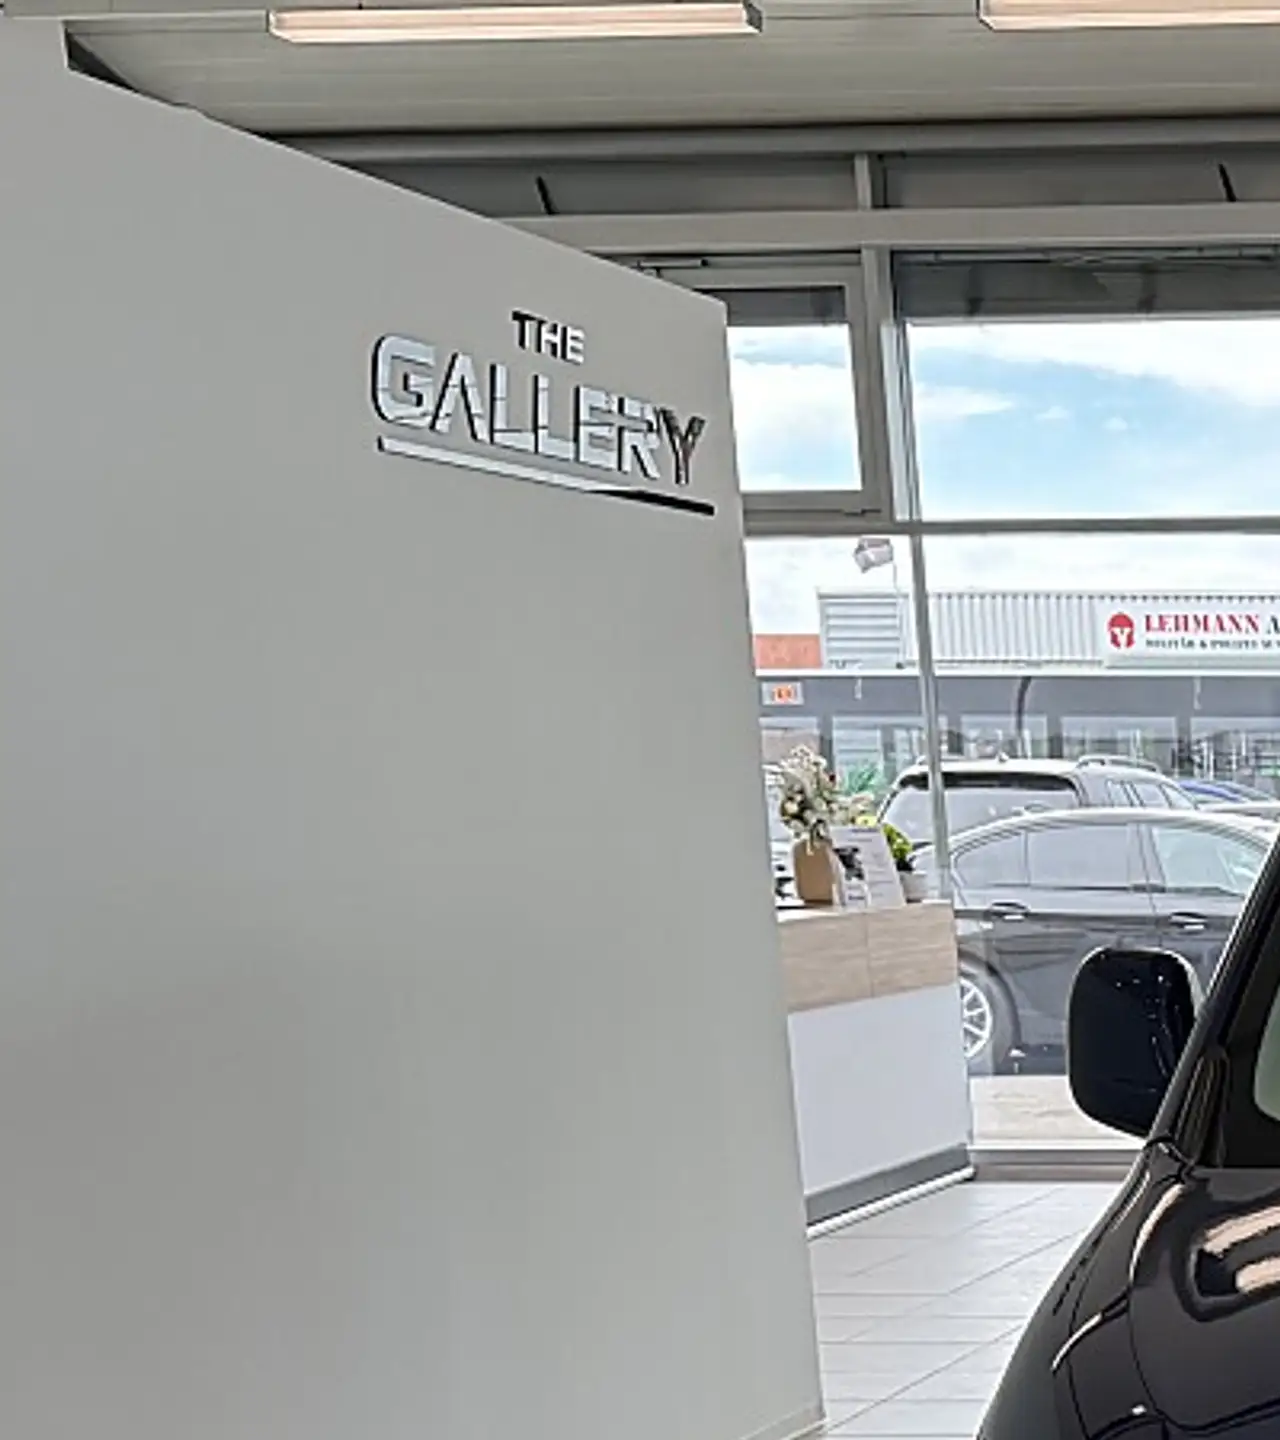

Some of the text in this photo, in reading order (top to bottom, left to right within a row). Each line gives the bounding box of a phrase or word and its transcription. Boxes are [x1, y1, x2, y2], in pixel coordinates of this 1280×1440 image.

[511, 309, 585, 364] THE
[371, 333, 704, 485] GALLERY
[1145, 612, 1260, 634] LEHMANN
